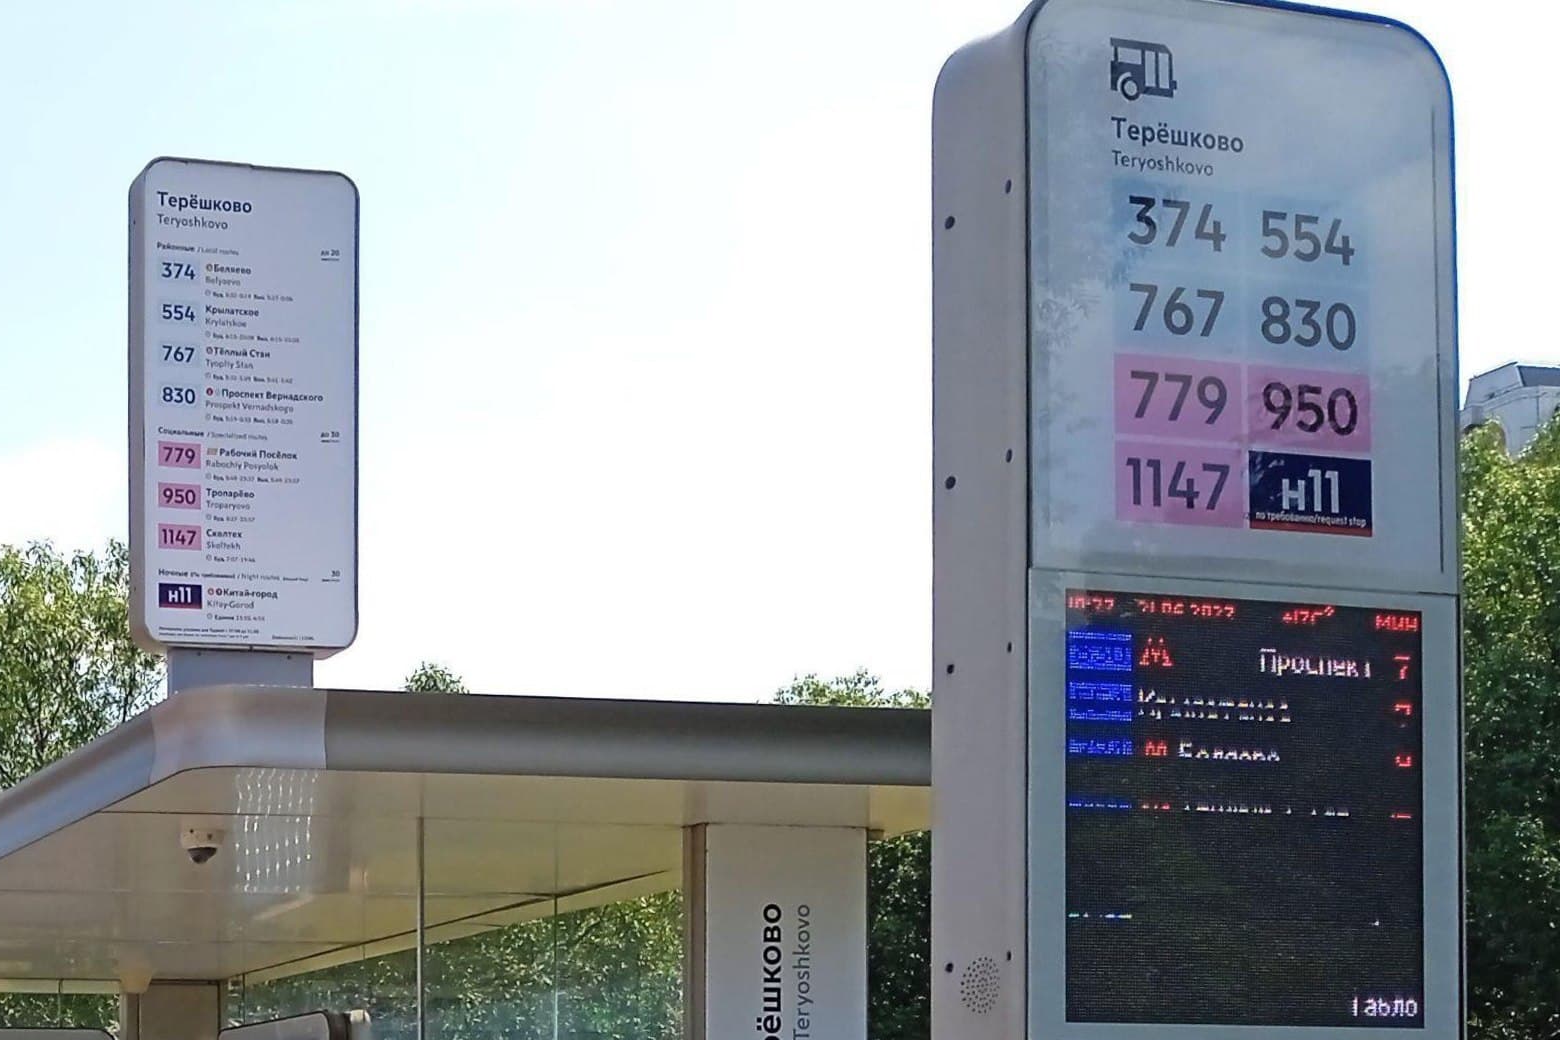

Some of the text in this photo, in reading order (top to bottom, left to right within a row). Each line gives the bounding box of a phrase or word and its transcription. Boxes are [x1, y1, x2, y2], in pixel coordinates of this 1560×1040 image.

[1110, 116, 1244, 154] Терёшково
[1112, 150, 1214, 177] Teryoshkovo
[156, 191, 252, 214] Терёшково
[157, 214, 228, 230] Teryoshkovo
[1126, 194, 1356, 266] 374 554
[162, 262, 196, 280] 374
[162, 304, 260, 322] 554 Крылатское
[1128, 283, 1356, 352] 767 830
[162, 345, 271, 363] 767 Тёплый Стан
[162, 386, 324, 405] 830 Проспект Вернадского
[1129, 370, 1359, 437] 779 950
[162, 446, 298, 464] 779 Рабочий Посёлок
[1126, 456, 1340, 514] 1147 н11
[162, 488, 255, 506] 950 Тропарёво
[1348, 516, 1367, 528] stop
[161, 528, 242, 546] 1147 Сколтех
[168, 586, 279, 604] н11 Китай-город
